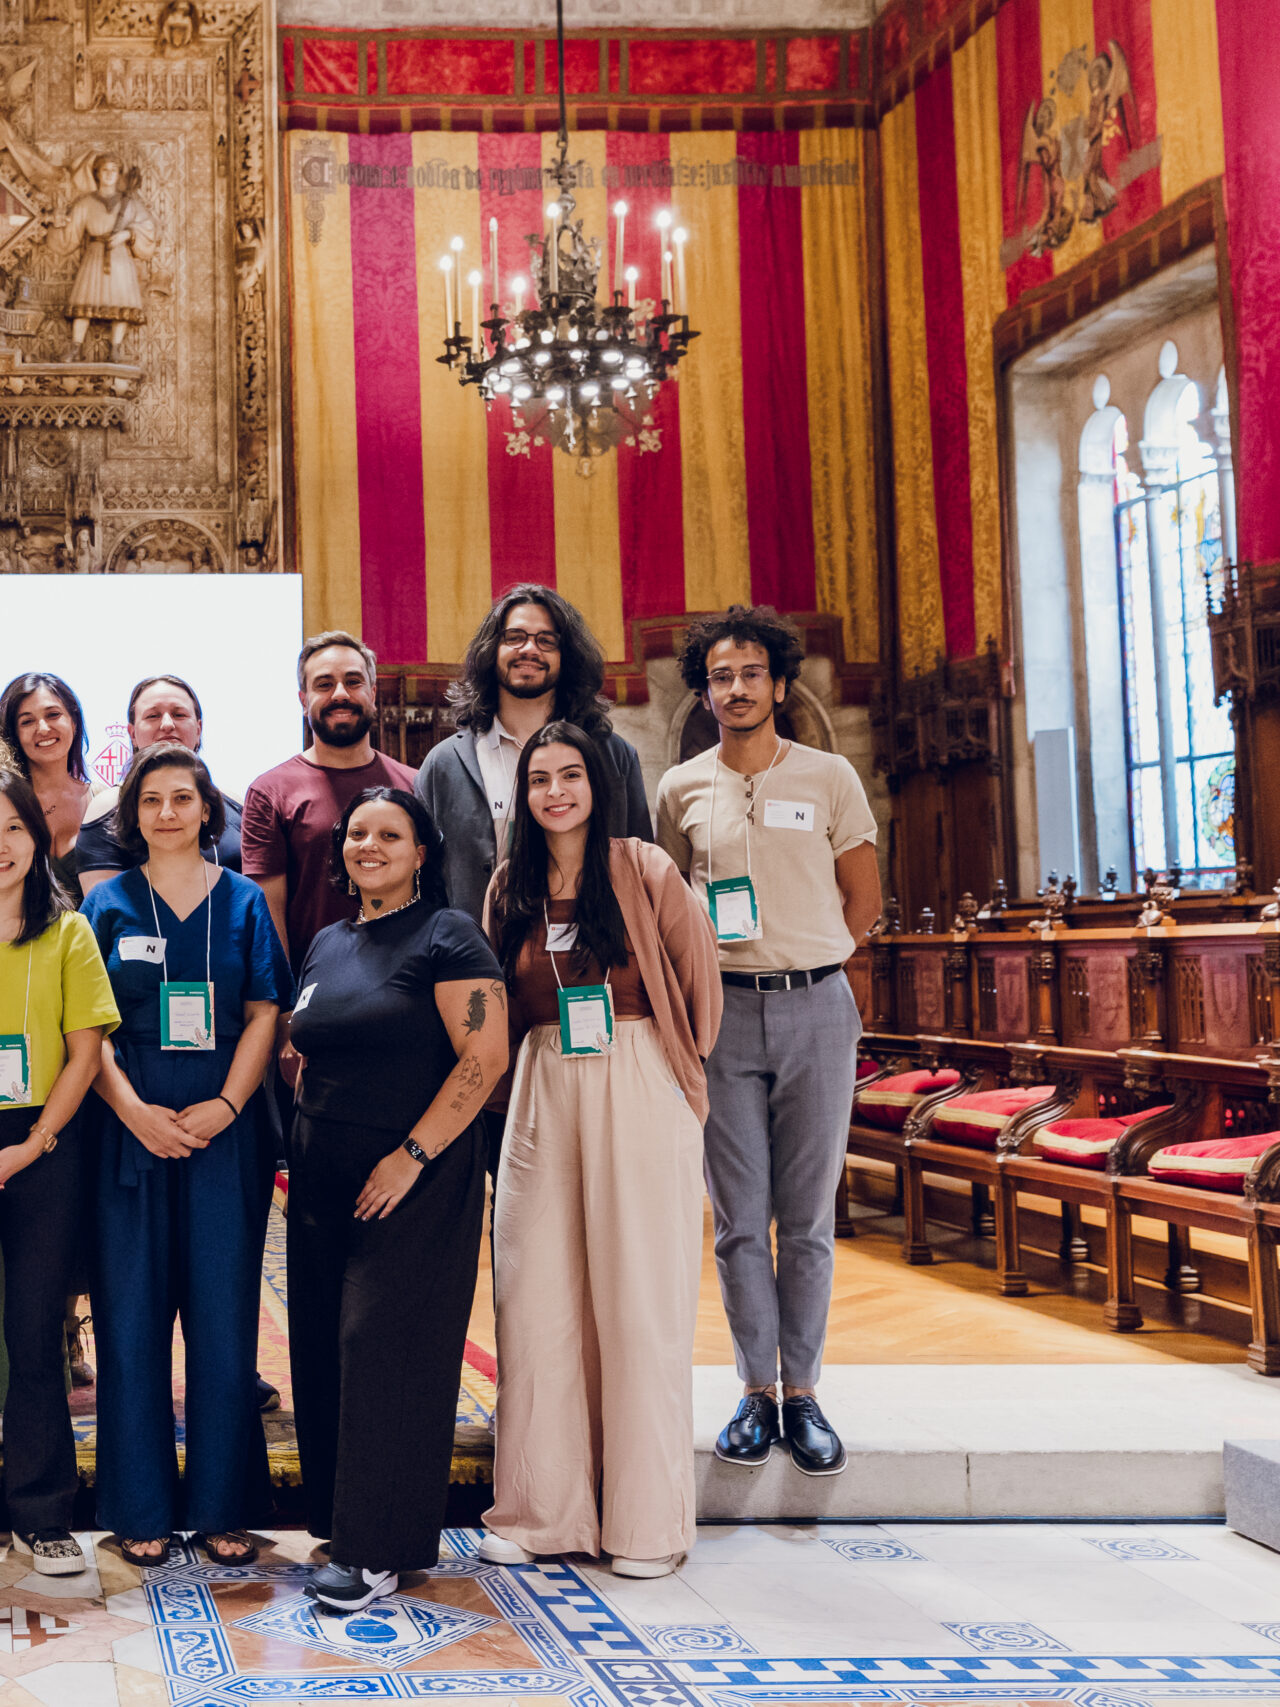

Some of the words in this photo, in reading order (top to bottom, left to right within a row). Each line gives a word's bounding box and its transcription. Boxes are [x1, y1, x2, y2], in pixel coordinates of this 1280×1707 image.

[494, 801, 503, 809] N
[795, 811, 805, 821] N
[146, 944, 156, 954] N
